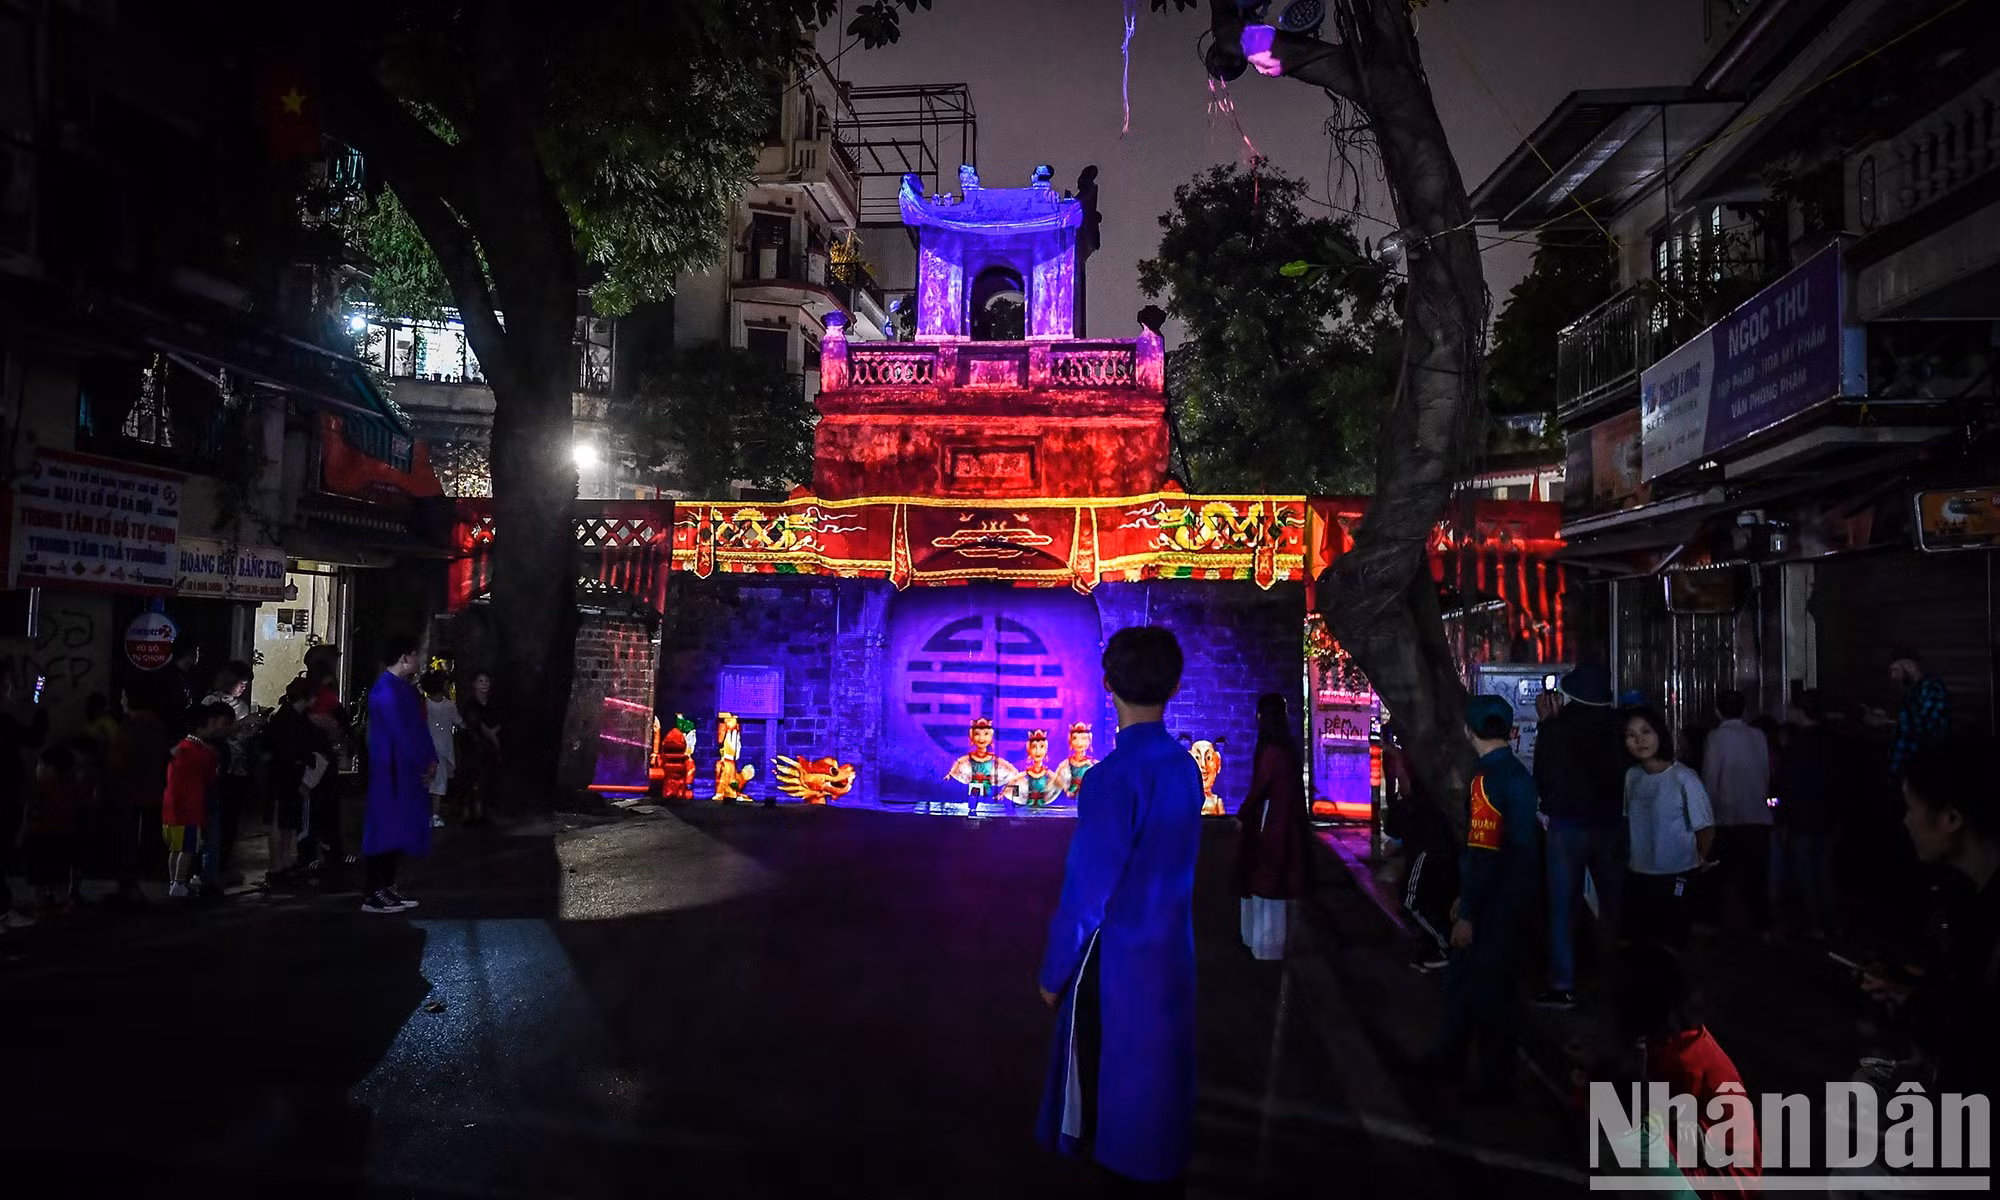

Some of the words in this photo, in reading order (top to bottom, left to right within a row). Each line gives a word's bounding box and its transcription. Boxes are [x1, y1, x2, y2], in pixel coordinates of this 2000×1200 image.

[1728, 305, 1770, 359] NGỌC
[1775, 277, 1809, 331] THU
[180, 548, 216, 574] HOÀNG
[1323, 714, 1353, 729] ĐÊM
